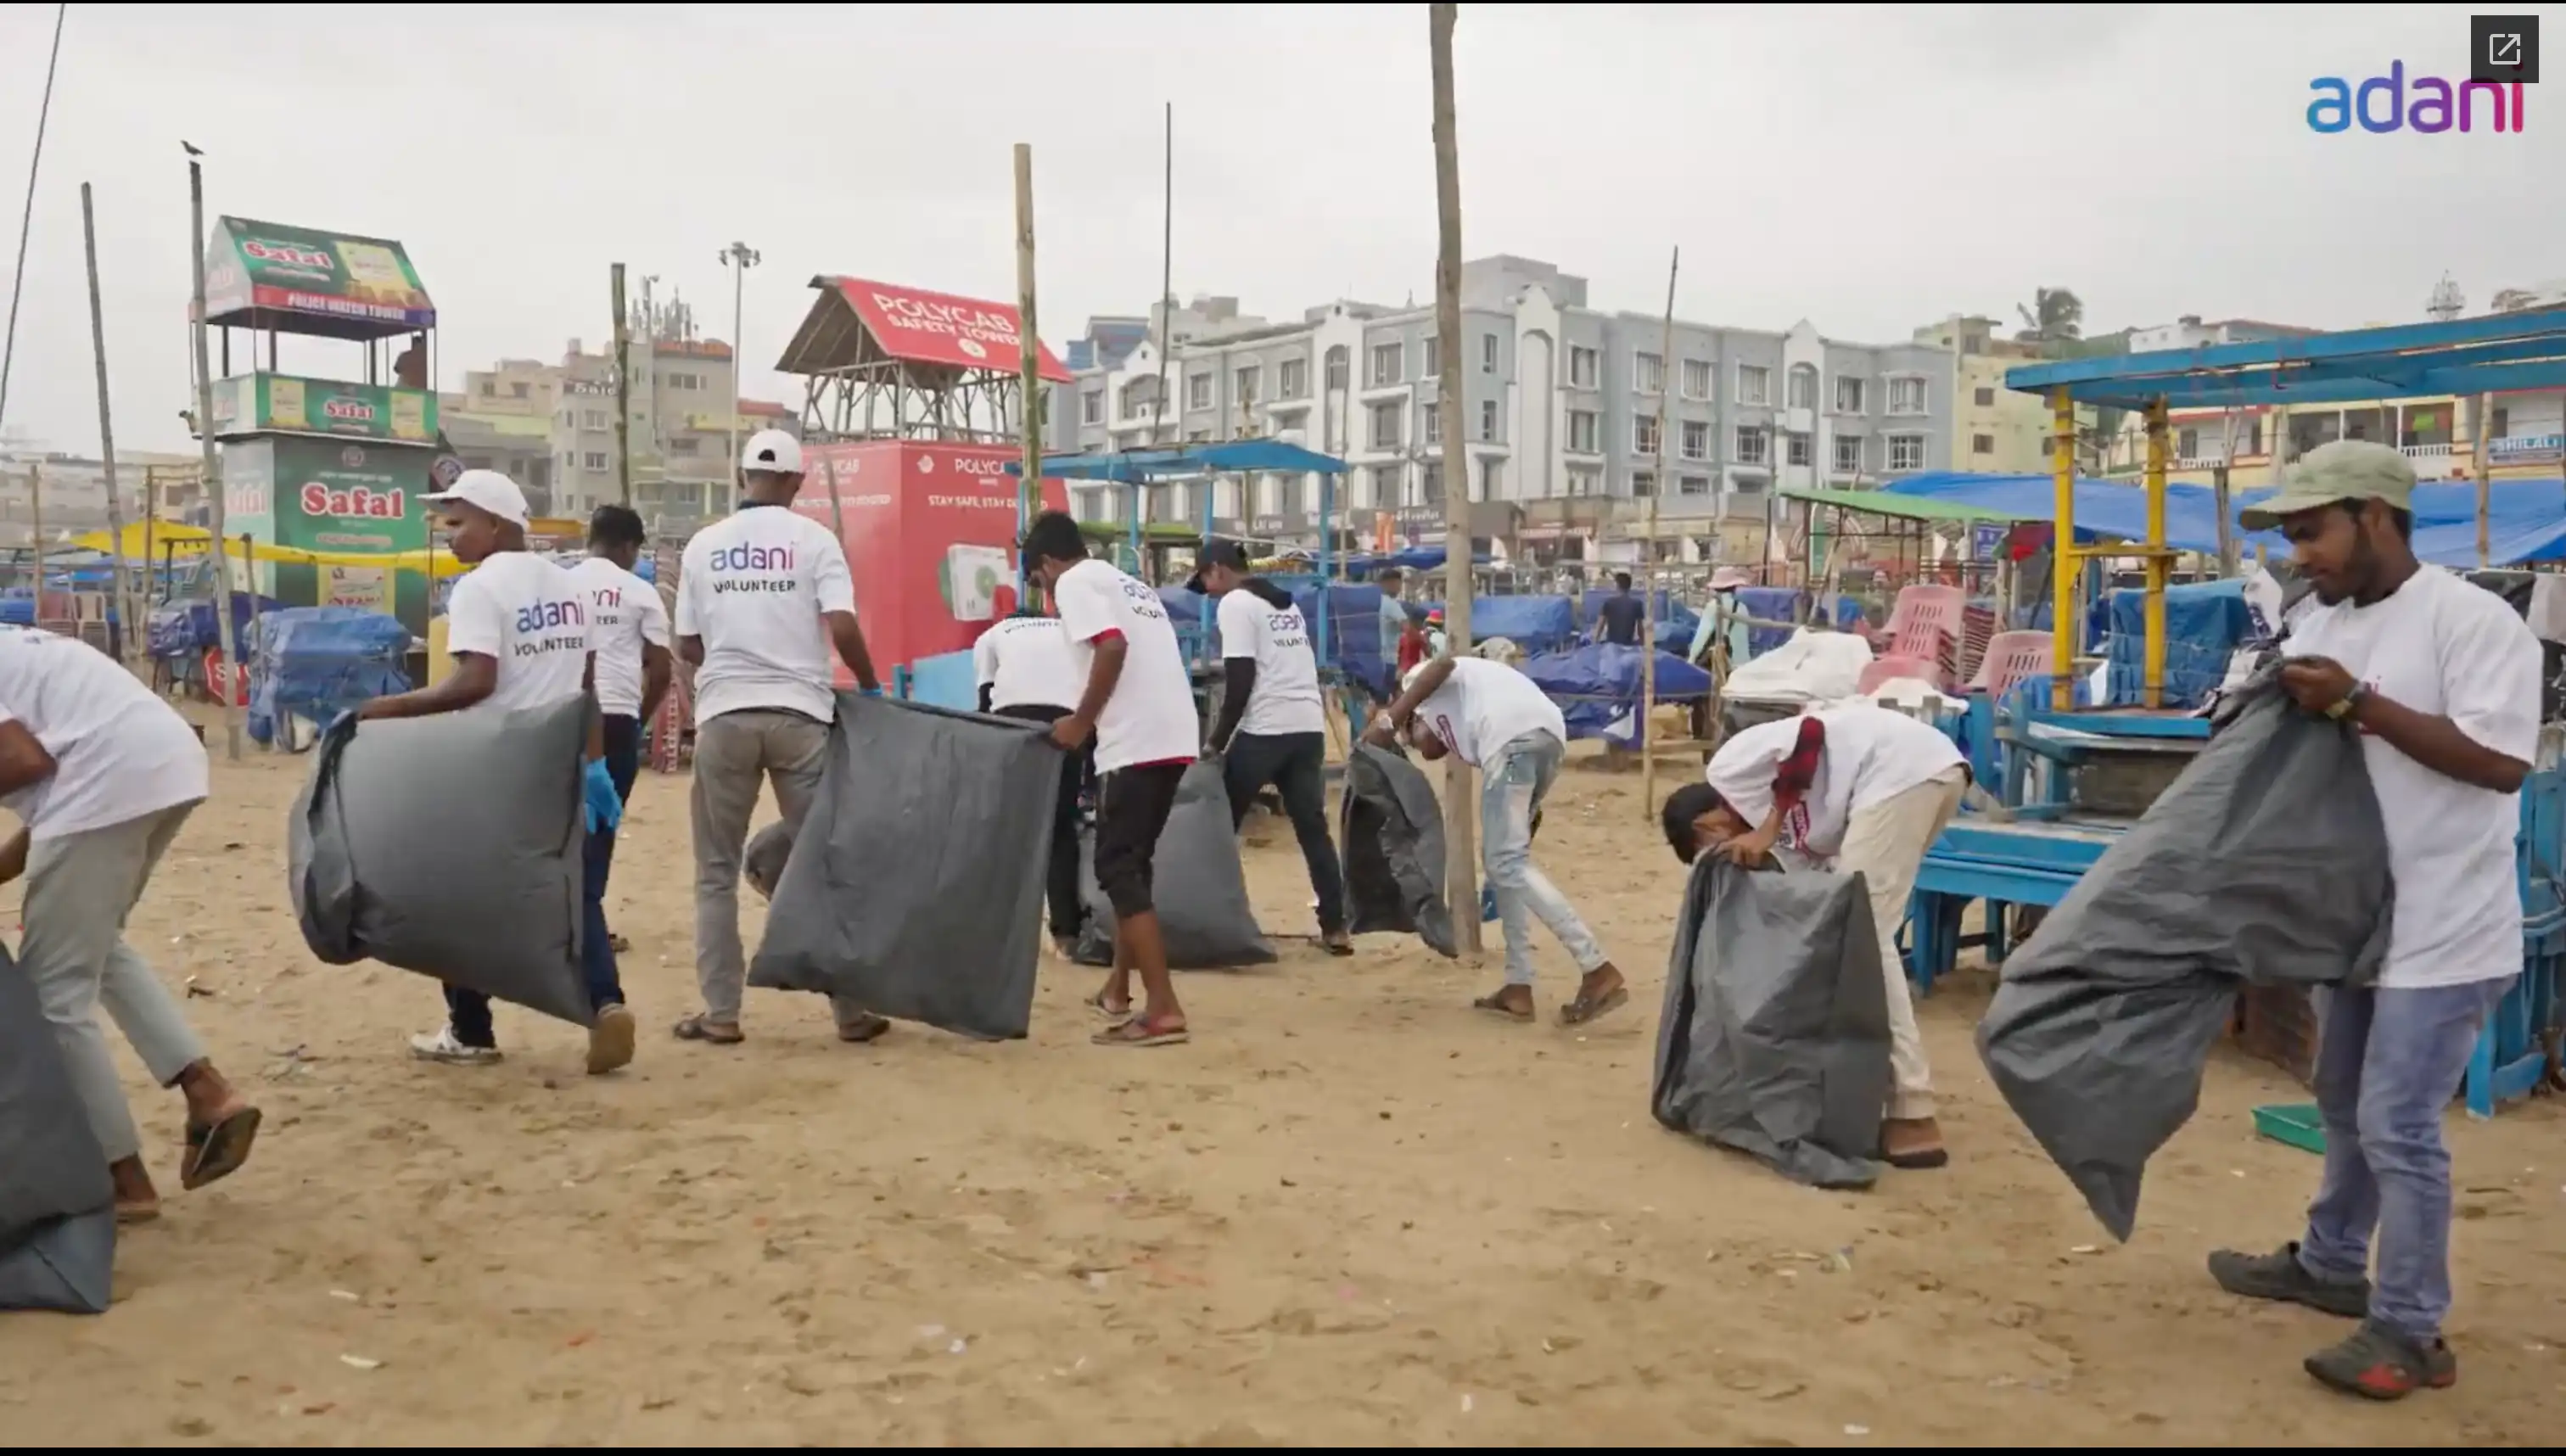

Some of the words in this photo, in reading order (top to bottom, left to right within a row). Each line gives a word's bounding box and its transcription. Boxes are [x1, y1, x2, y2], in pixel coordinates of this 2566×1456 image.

[244, 240, 334, 270] Safal
[288, 292, 326, 311] POLICE
[871, 292, 1015, 333] POLYCAB
[887, 314, 957, 335] SAFETY
[324, 400, 375, 420] Safal
[301, 481, 405, 519] Safal
[710, 540, 793, 572] adani
[714, 580, 796, 593] VOLUNTEER
[516, 594, 585, 634] adani
